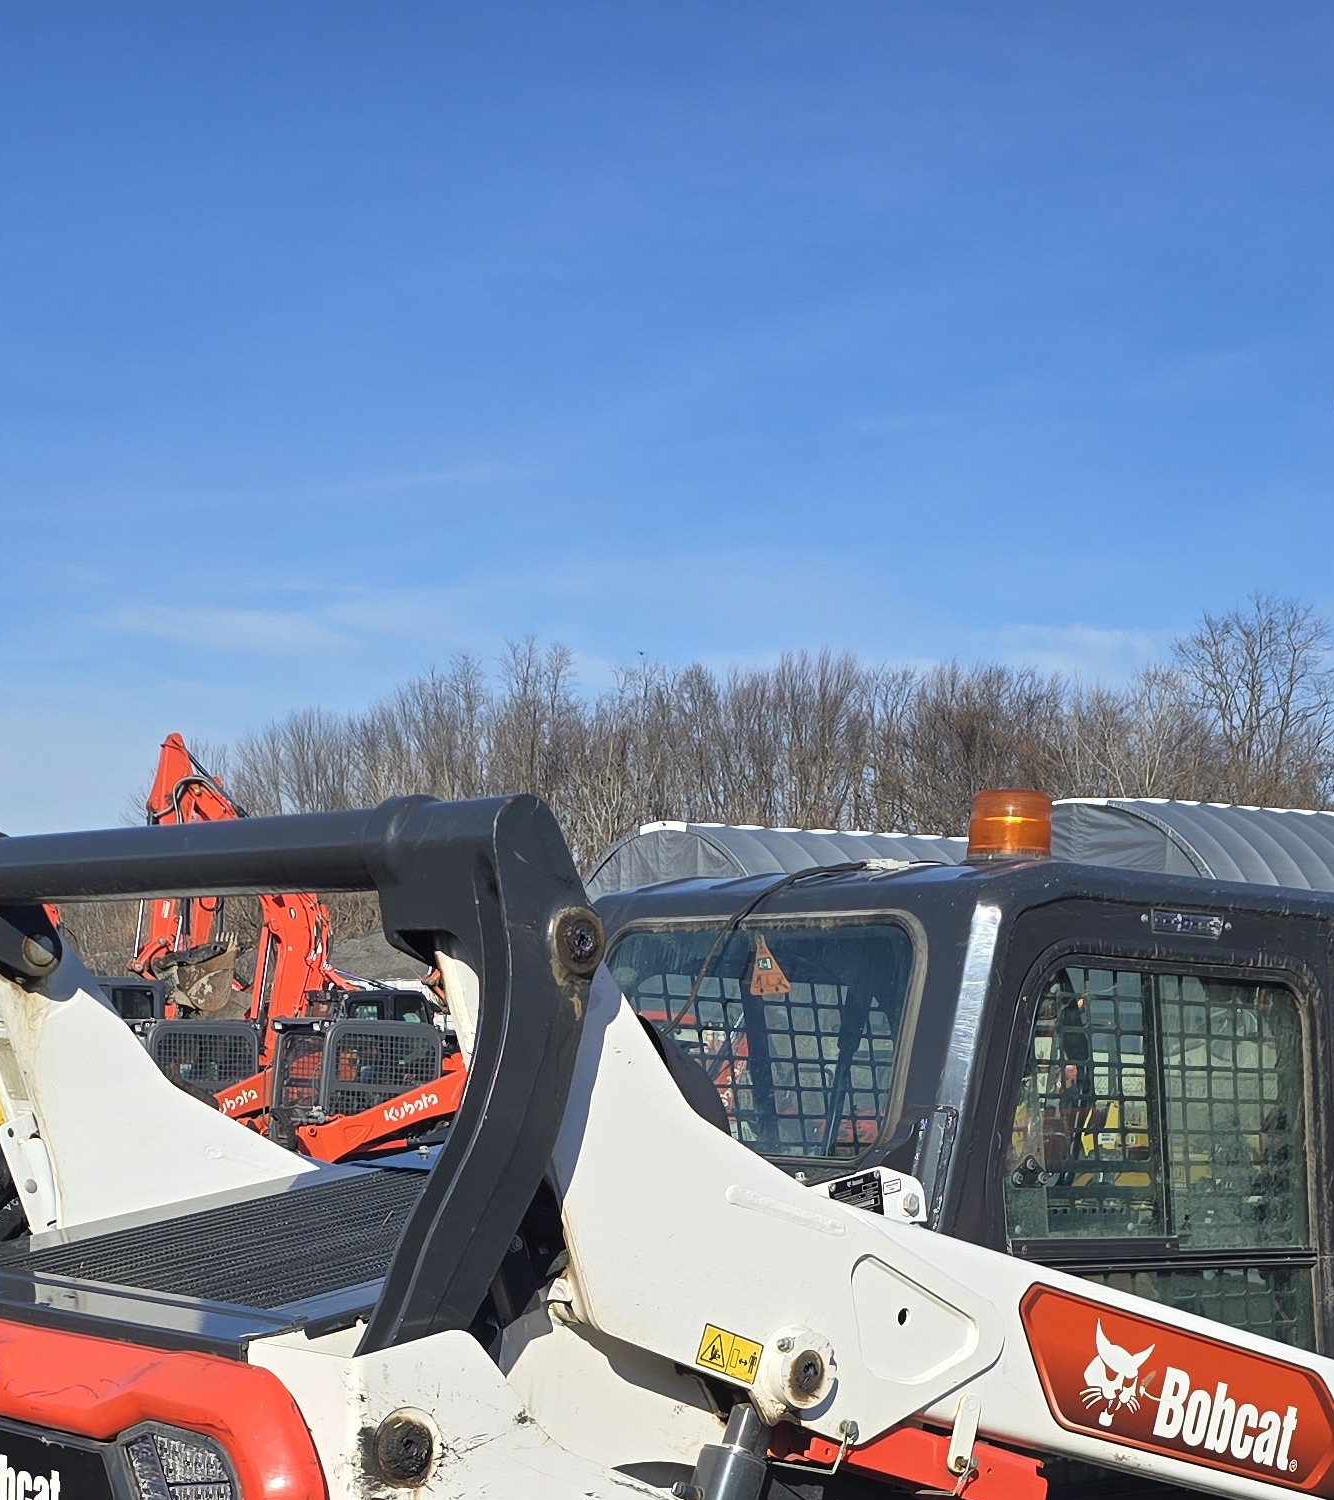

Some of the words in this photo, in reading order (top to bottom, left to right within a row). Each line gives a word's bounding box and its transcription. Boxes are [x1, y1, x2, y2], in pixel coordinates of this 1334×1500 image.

[218, 1087, 259, 1116] ubota
[383, 1092, 439, 1122] Kubota
[1152, 1366, 1298, 1471] Bobcat
